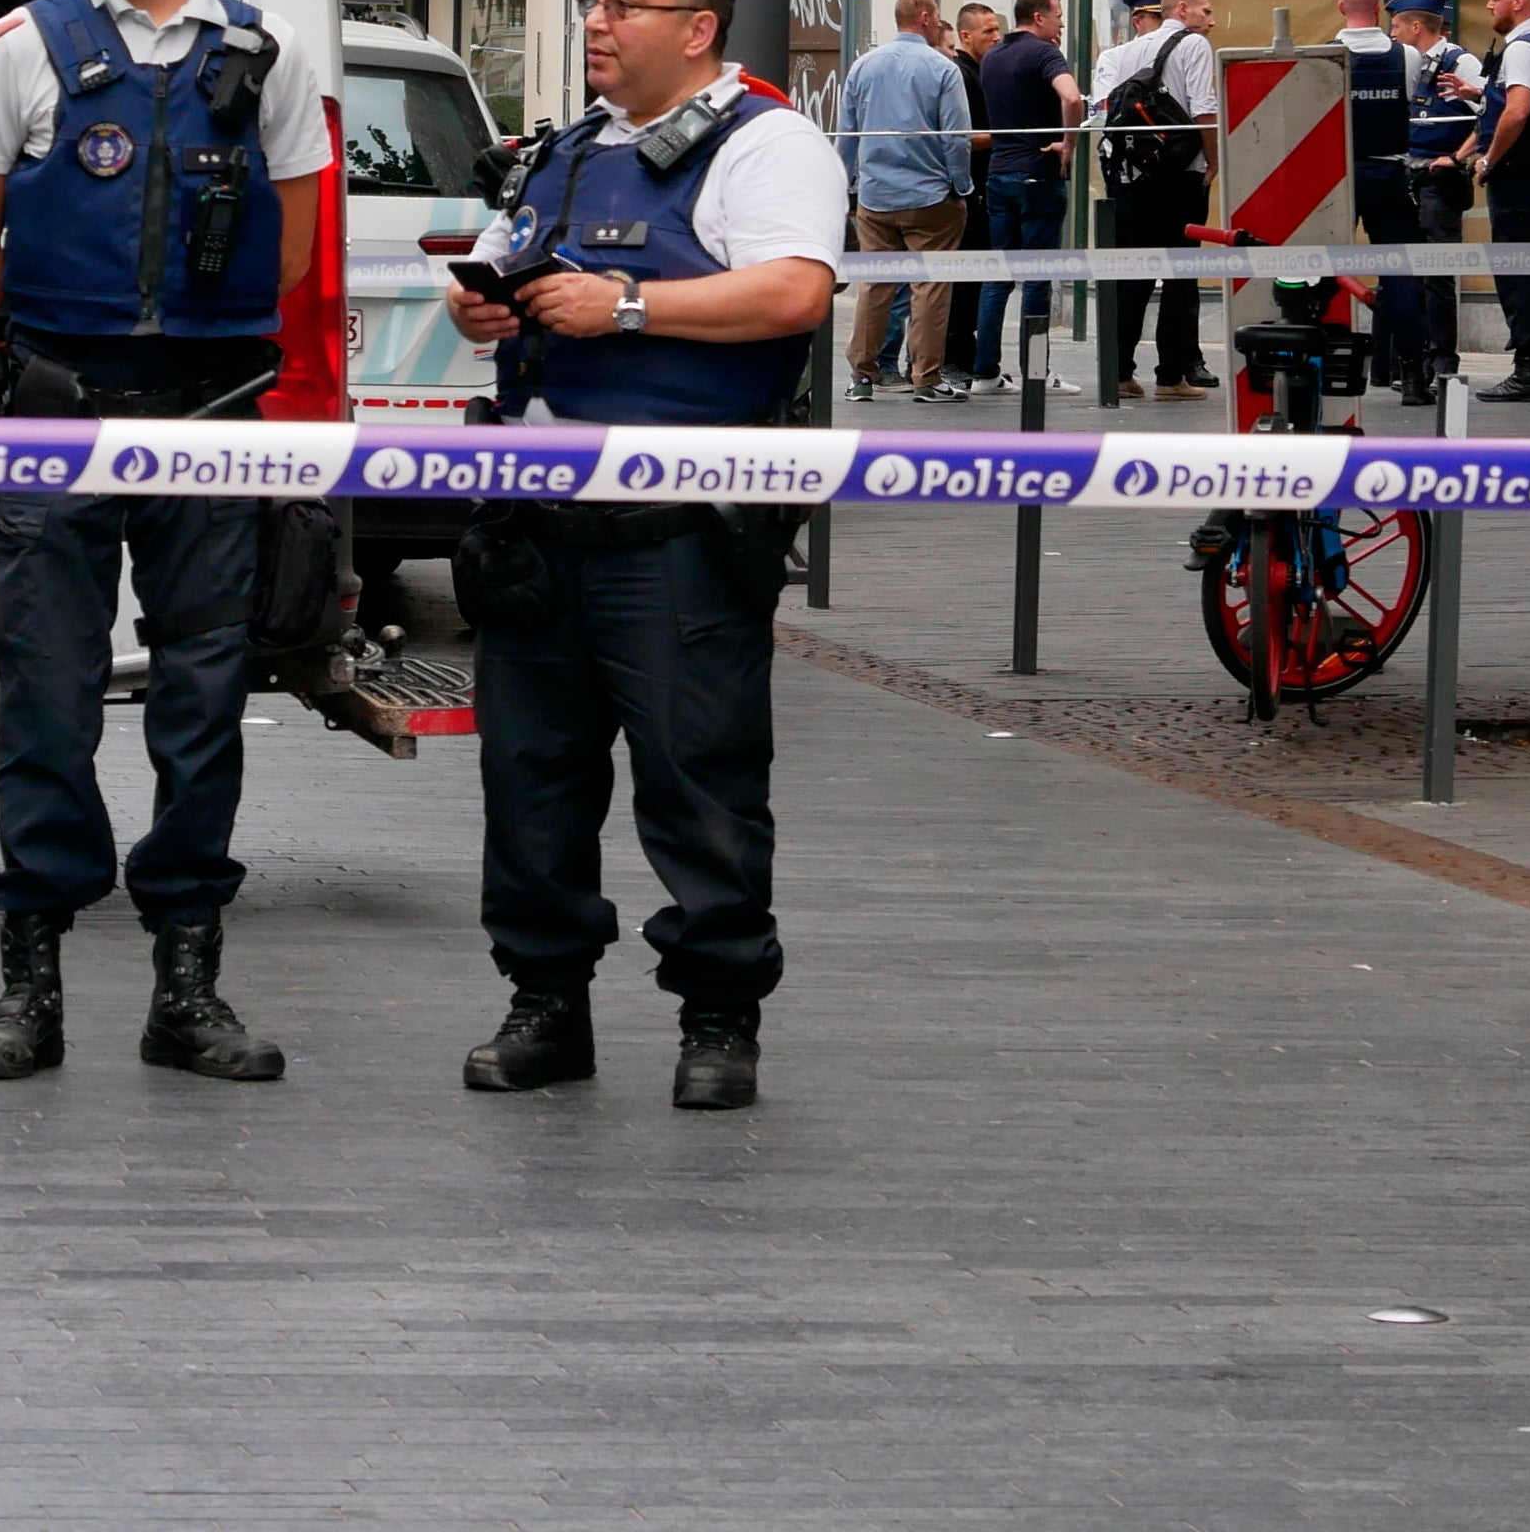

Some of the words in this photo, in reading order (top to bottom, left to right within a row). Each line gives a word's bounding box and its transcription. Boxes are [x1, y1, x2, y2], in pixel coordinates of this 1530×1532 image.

[1350, 89, 1399, 100] POLICE
[170, 448, 320, 485] Politie
[421, 452, 576, 492] Police
[672, 455, 824, 494] Politie
[918, 457, 1072, 499] Police
[1168, 461, 1314, 500] Politie
